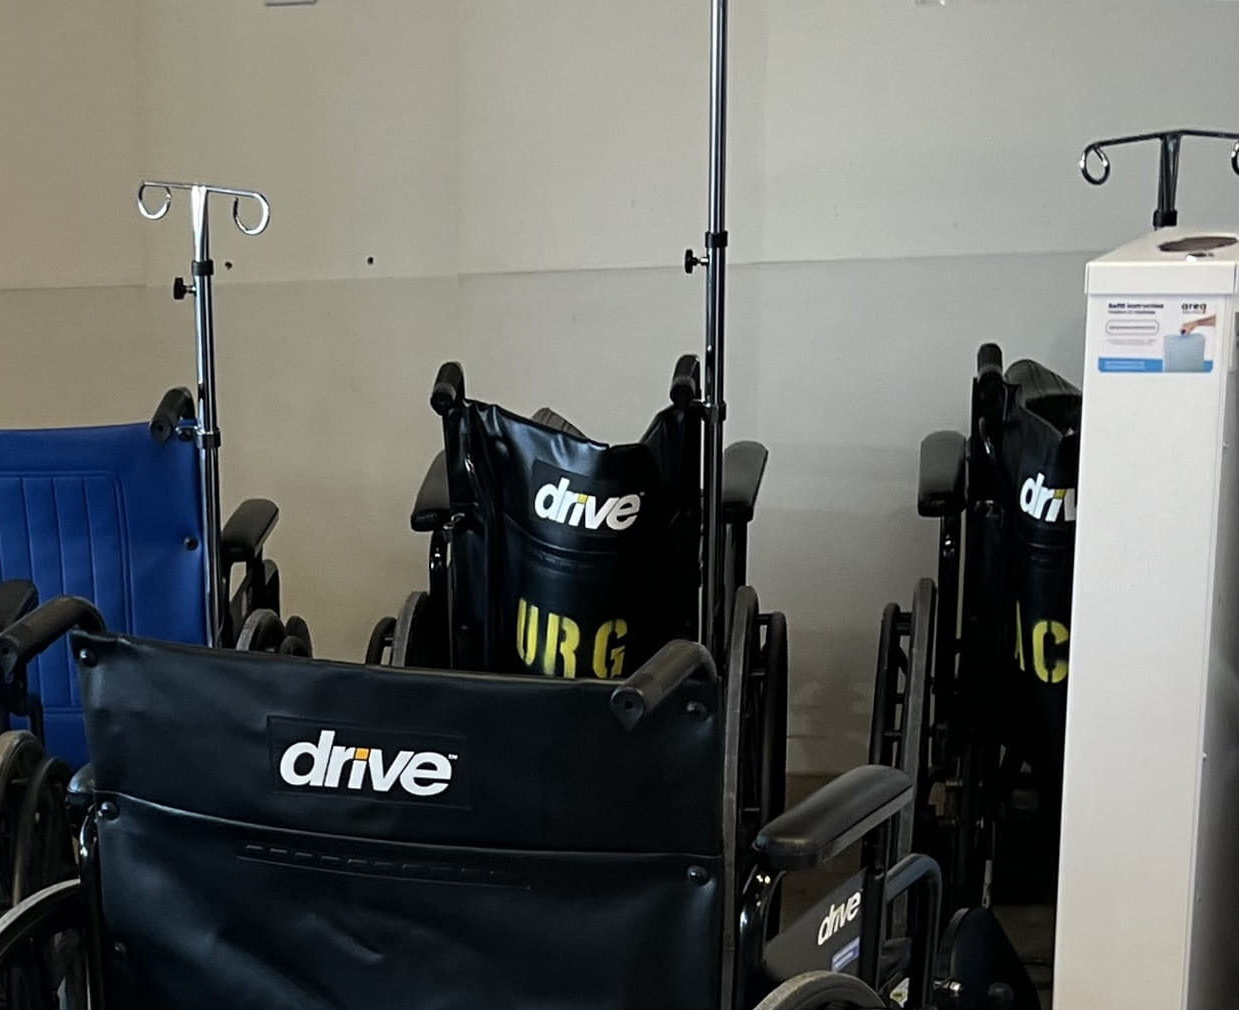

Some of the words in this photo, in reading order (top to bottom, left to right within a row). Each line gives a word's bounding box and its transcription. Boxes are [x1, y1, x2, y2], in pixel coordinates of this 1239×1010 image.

[534, 477, 641, 531] drive
[279, 730, 453, 797] drive
[817, 891, 862, 946] drive
